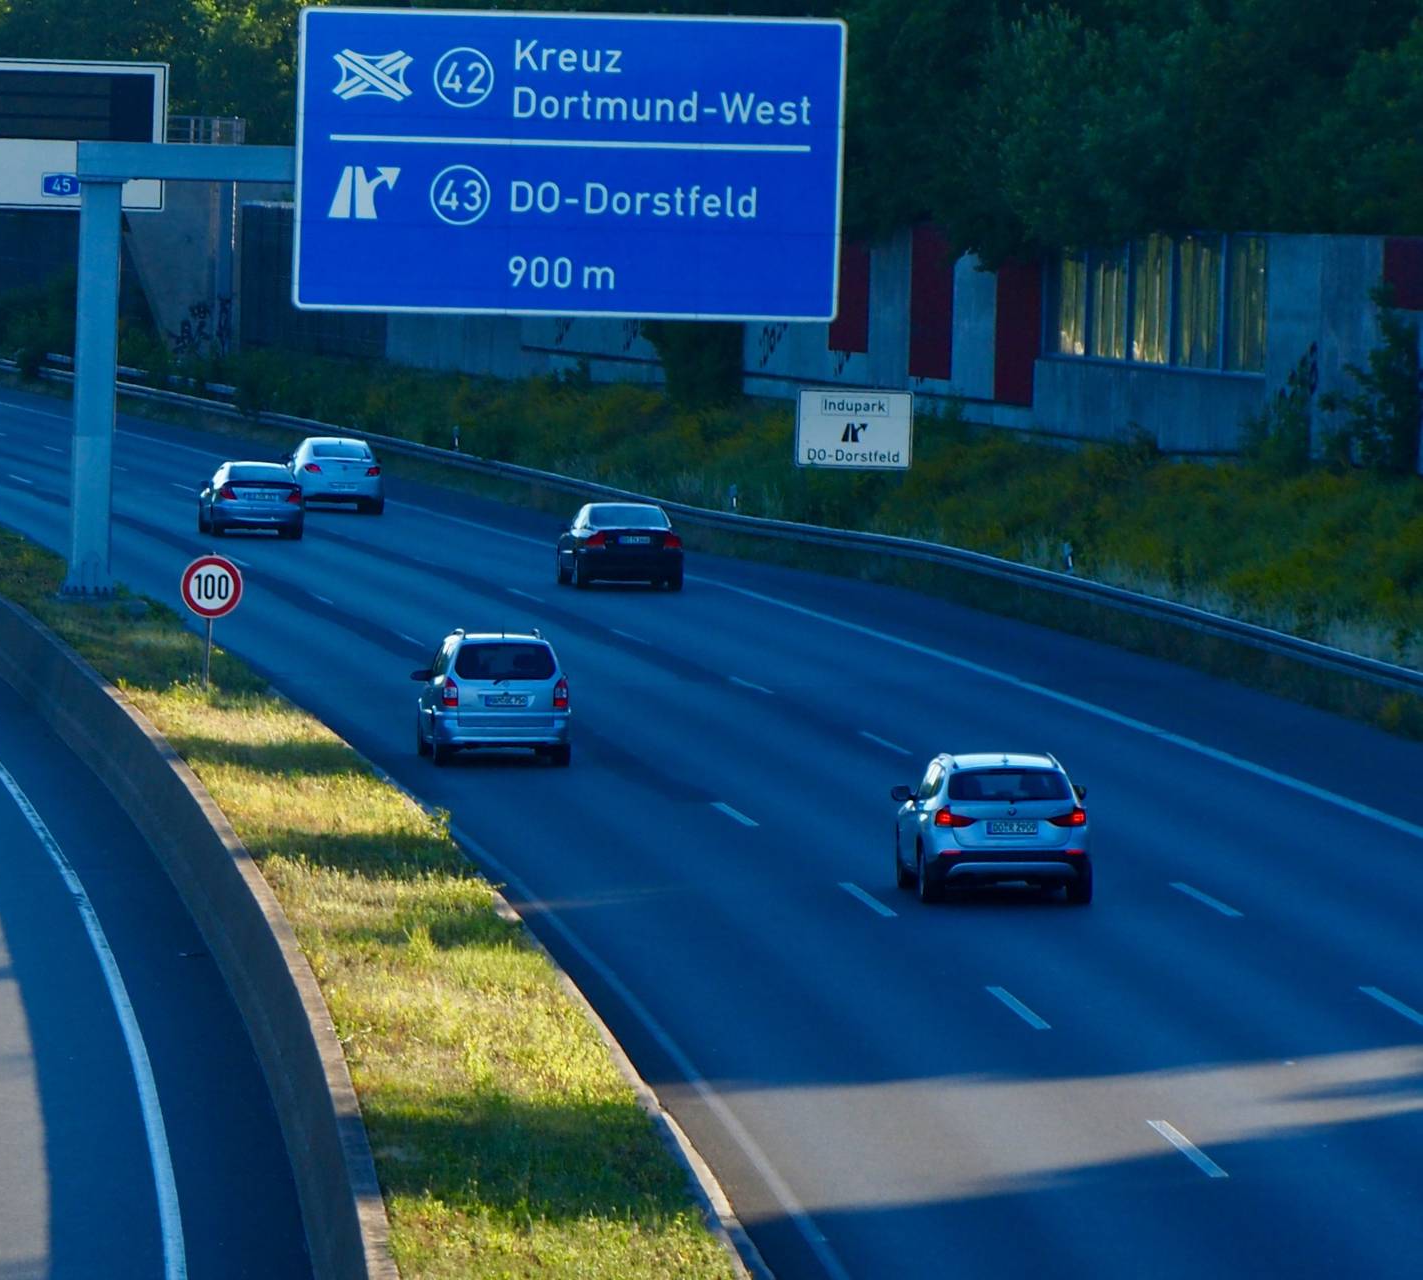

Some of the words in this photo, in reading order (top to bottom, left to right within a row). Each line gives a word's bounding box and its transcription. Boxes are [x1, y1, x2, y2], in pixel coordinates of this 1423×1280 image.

[441, 61, 486, 94] 42
[514, 38, 623, 74] Kreuz
[513, 86, 811, 126] Dortmund-West
[52, 177, 71, 193] 45
[438, 183, 483, 212] 43
[510, 180, 758, 218] DO-Dorstfeld
[507, 255, 573, 289] 900
[582, 265, 616, 290] m
[823, 398, 886, 414] Indupark
[807, 447, 900, 464] DO-Dorstfeld
[194, 573, 230, 601] 100
